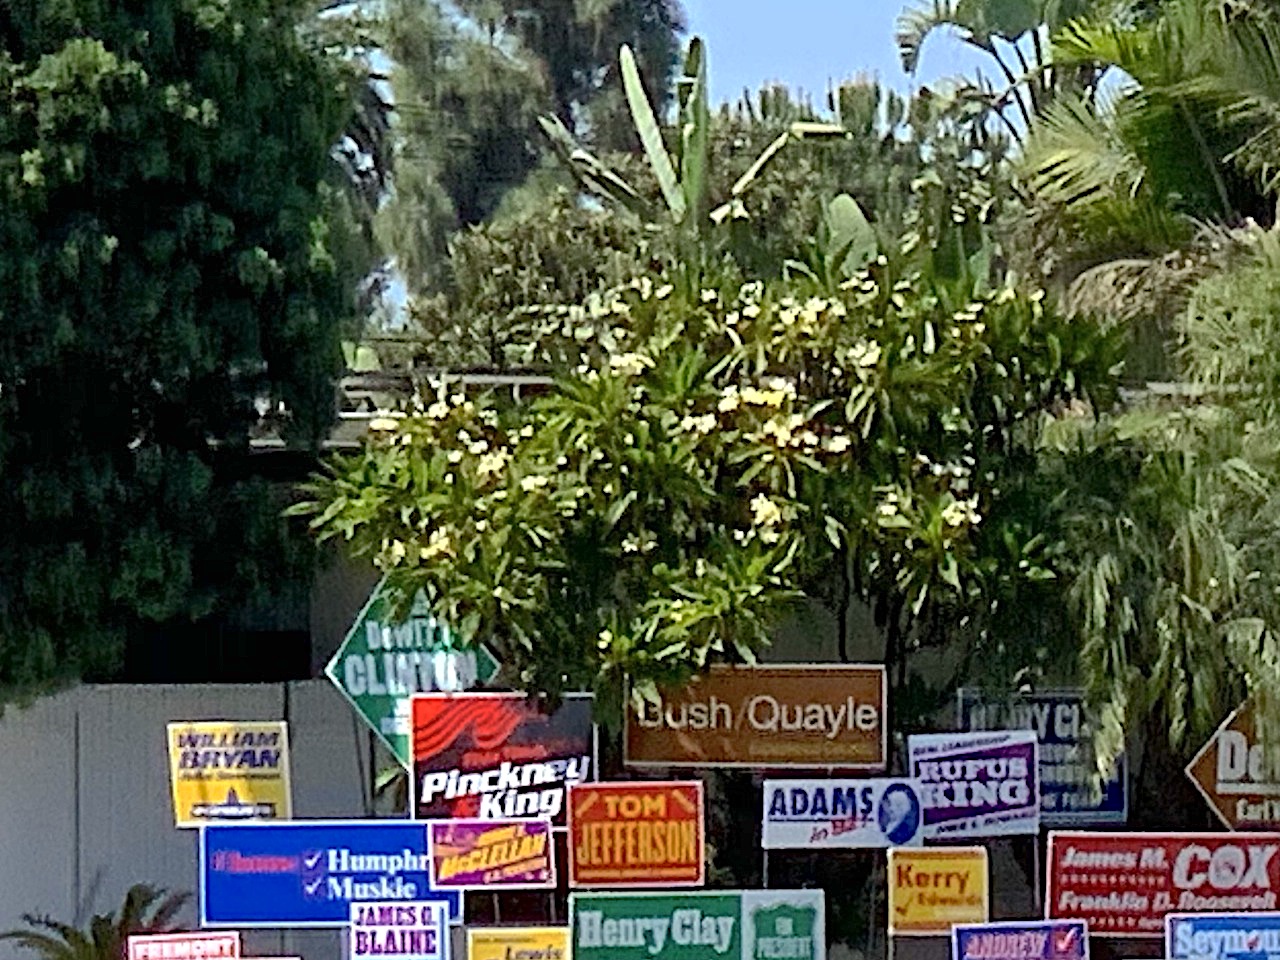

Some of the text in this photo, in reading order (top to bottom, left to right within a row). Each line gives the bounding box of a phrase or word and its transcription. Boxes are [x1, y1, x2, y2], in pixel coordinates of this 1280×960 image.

[344, 650, 478, 696] CLINTON
[178, 732, 279, 748] WILLIAM
[180, 749, 280, 769] BRYAN
[918, 757, 1029, 783] RUFUS
[420, 756, 590, 803] Pinckney
[479, 787, 564, 819] King
[603, 794, 668, 818] TOM
[768, 787, 874, 816] ADAMS
[920, 779, 1029, 809] KING
[577, 820, 697, 866] JEFFERSON
[327, 849, 428, 875] Humphr
[1060, 846, 1138, 869] James
[1172, 842, 1280, 890] COX
[327, 877, 417, 899] Muskie
[896, 865, 970, 893] Kerry
[354, 905, 417, 927] JAMES
[355, 929, 437, 955] BLAINE
[577, 908, 735, 955] Henry Clay
